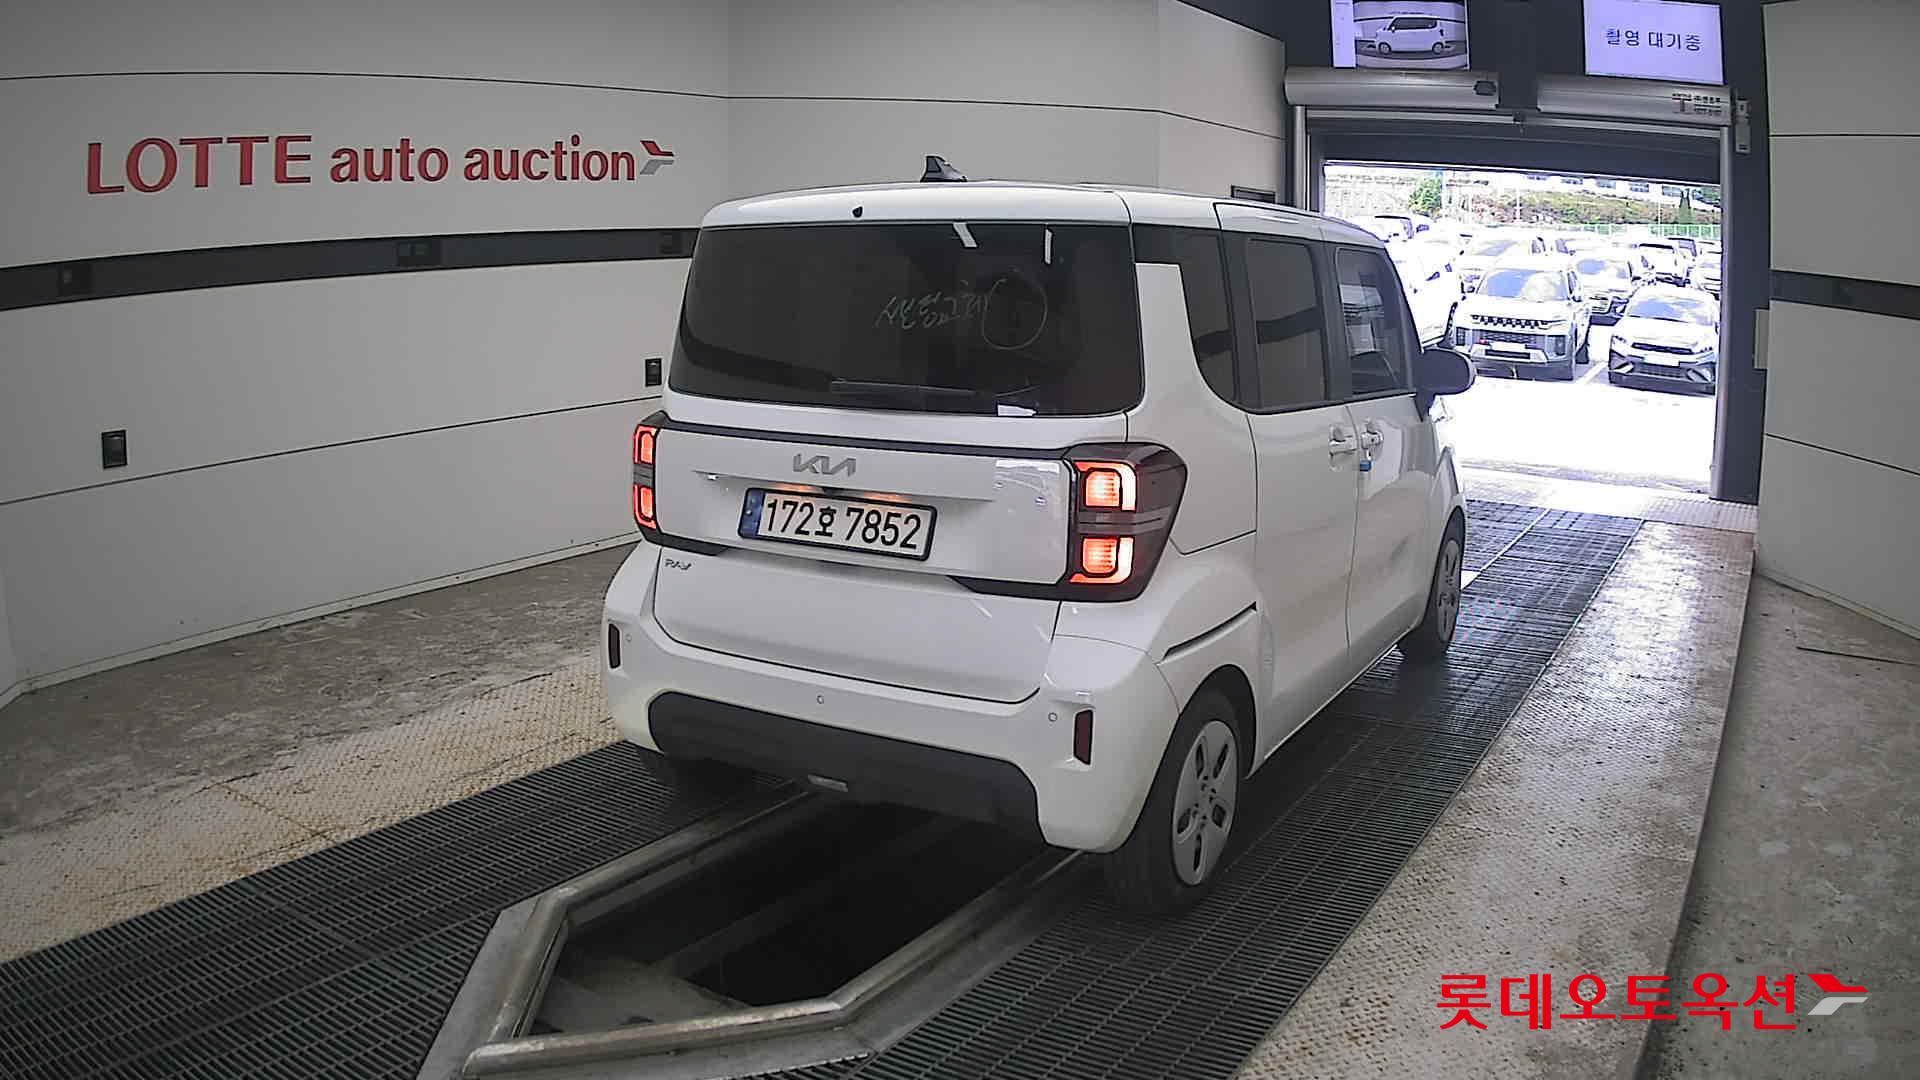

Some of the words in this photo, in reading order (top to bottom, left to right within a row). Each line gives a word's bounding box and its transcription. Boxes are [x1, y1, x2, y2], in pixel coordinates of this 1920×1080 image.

[1648, 31, 1702, 52] 대기중
[86, 134, 312, 194] LOTTE
[329, 137, 449, 183] auto
[462, 134, 637, 183] auction
[766, 498, 837, 538] 172호
[845, 505, 922, 550] 7852
